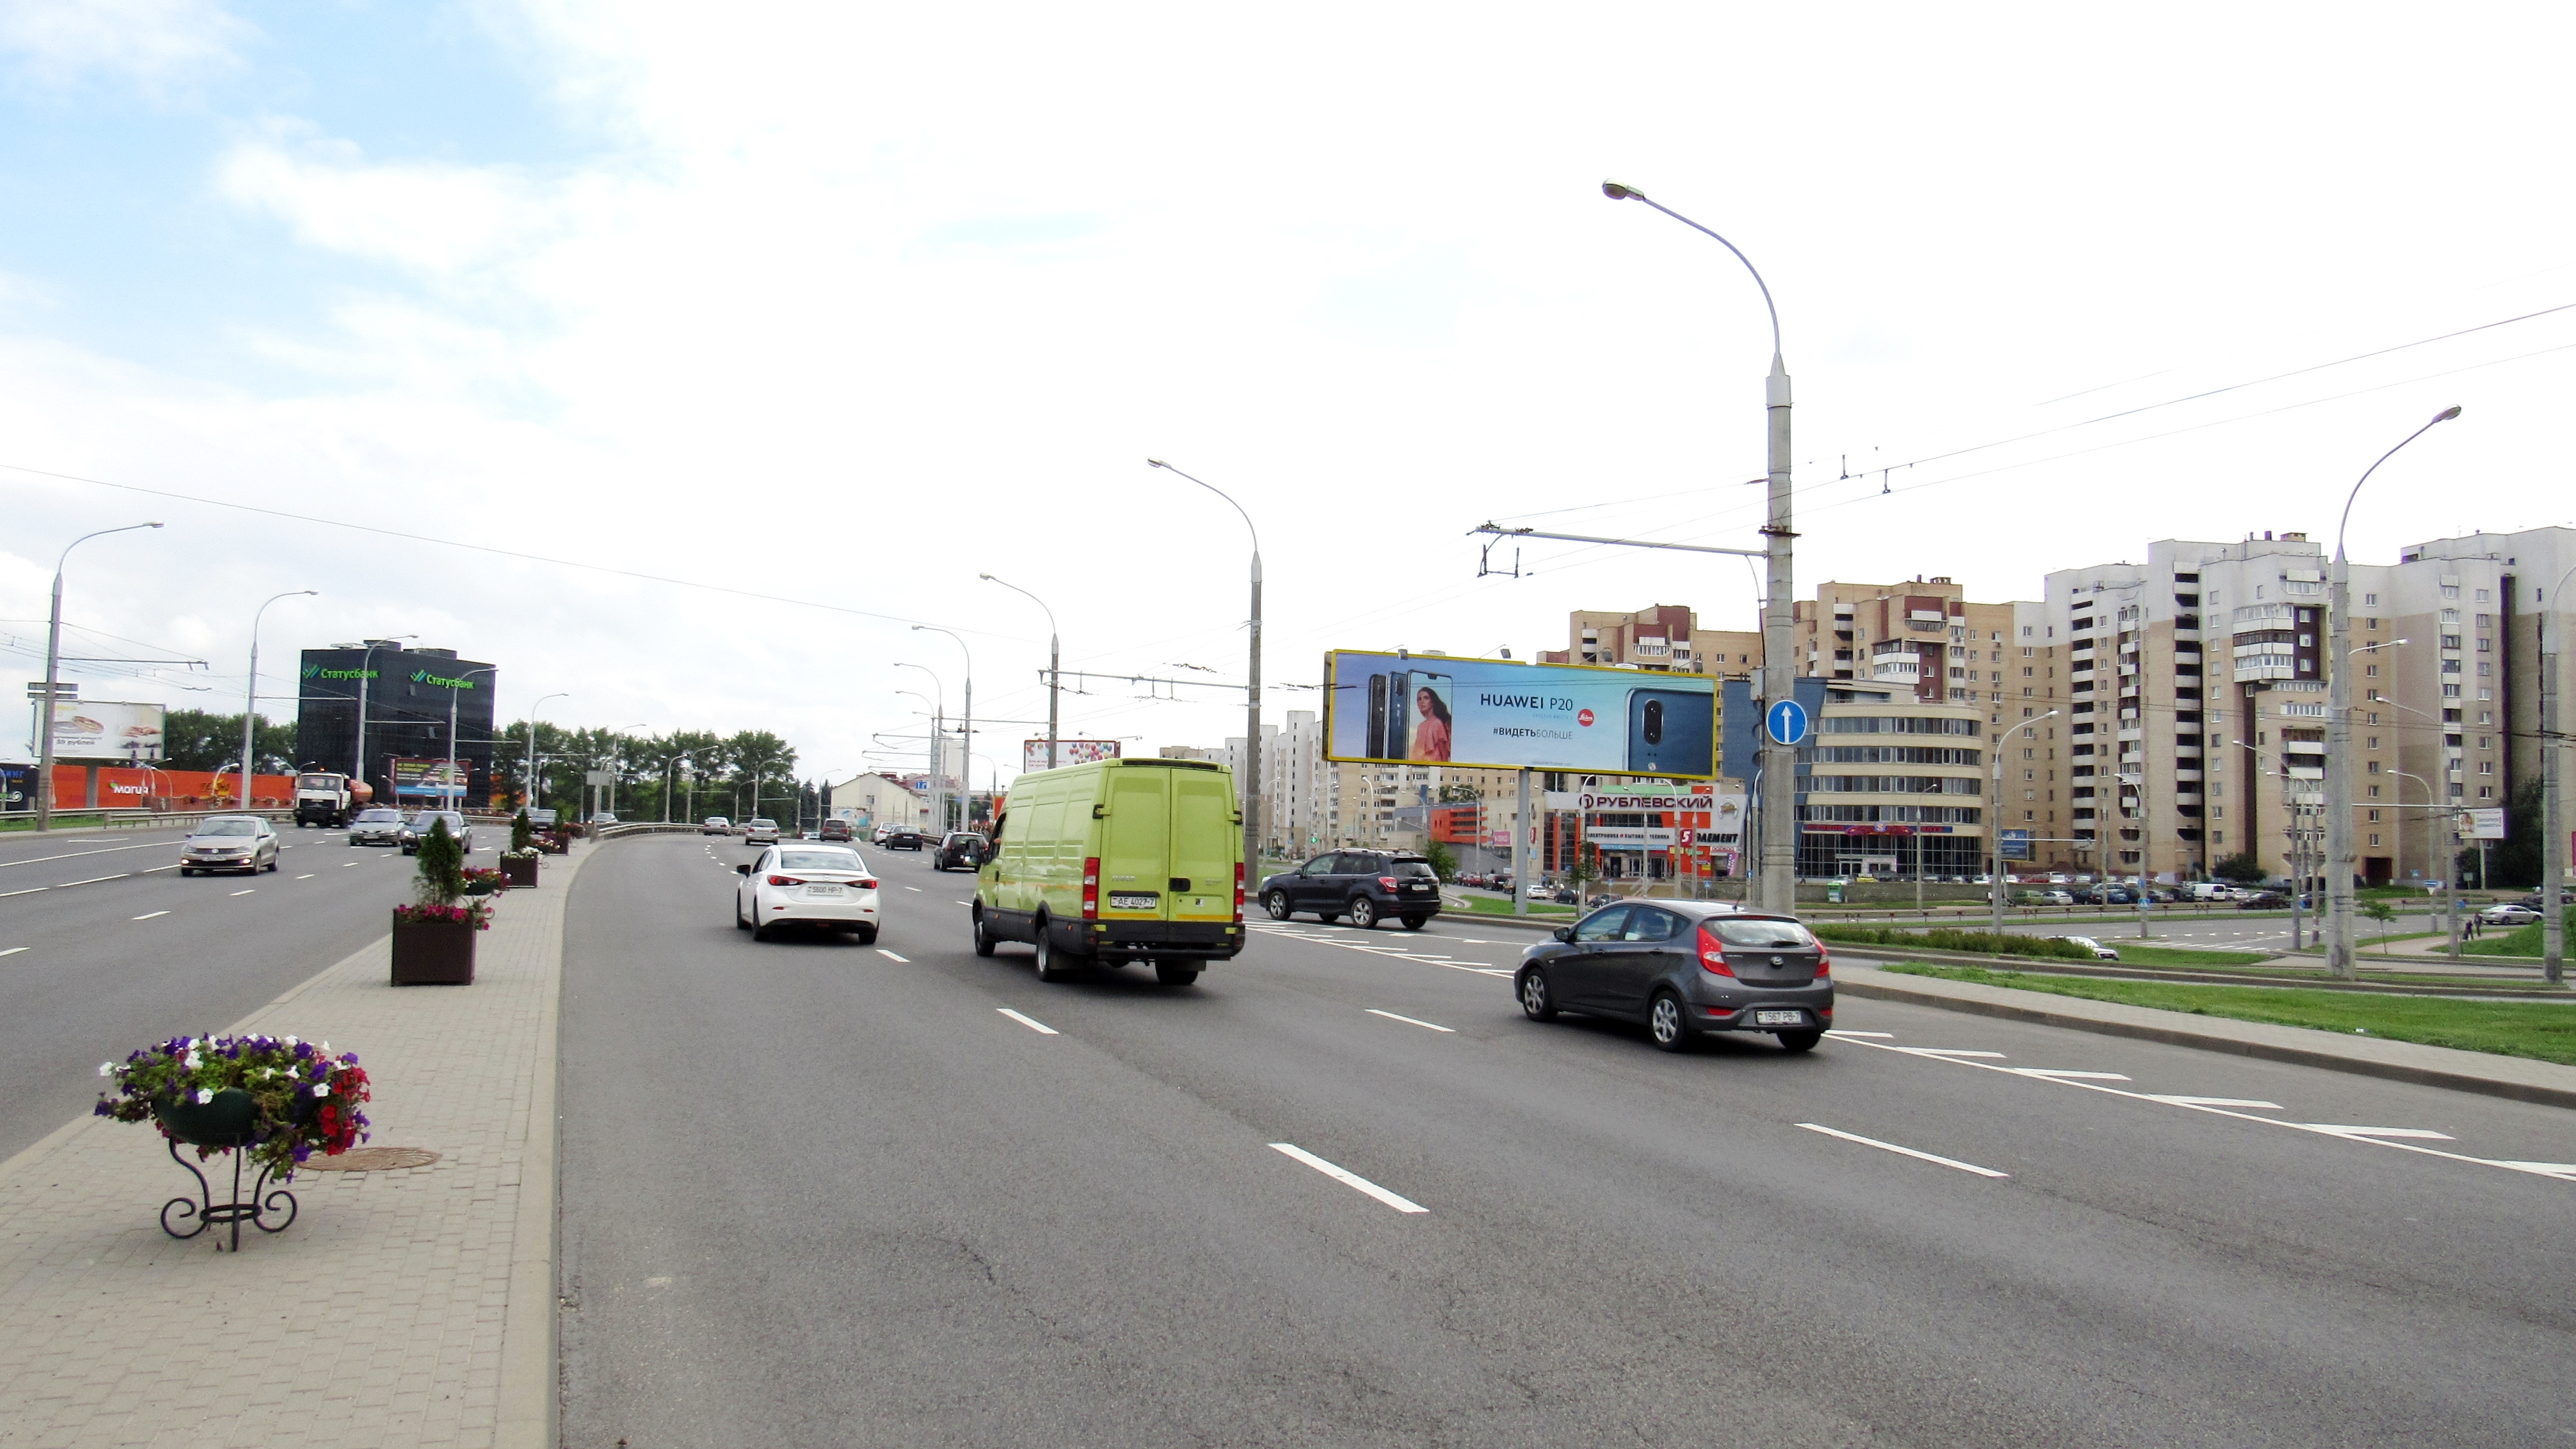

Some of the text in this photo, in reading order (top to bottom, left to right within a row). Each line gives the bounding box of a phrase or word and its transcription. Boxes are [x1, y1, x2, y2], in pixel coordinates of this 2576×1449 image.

[320, 668, 379, 681] Статусбанк
[426, 674, 474, 689] Статусбанк
[1481, 693, 1573, 711] HUAWEI P20
[1493, 727, 1573, 740] #ВИДЕТЬБОЛЬШЕ
[1597, 795, 1713, 808] РУБЛЕВСКИЙ
[1681, 831, 1691, 842] 5
[1117, 897, 1154, 906] AE 4027-7
